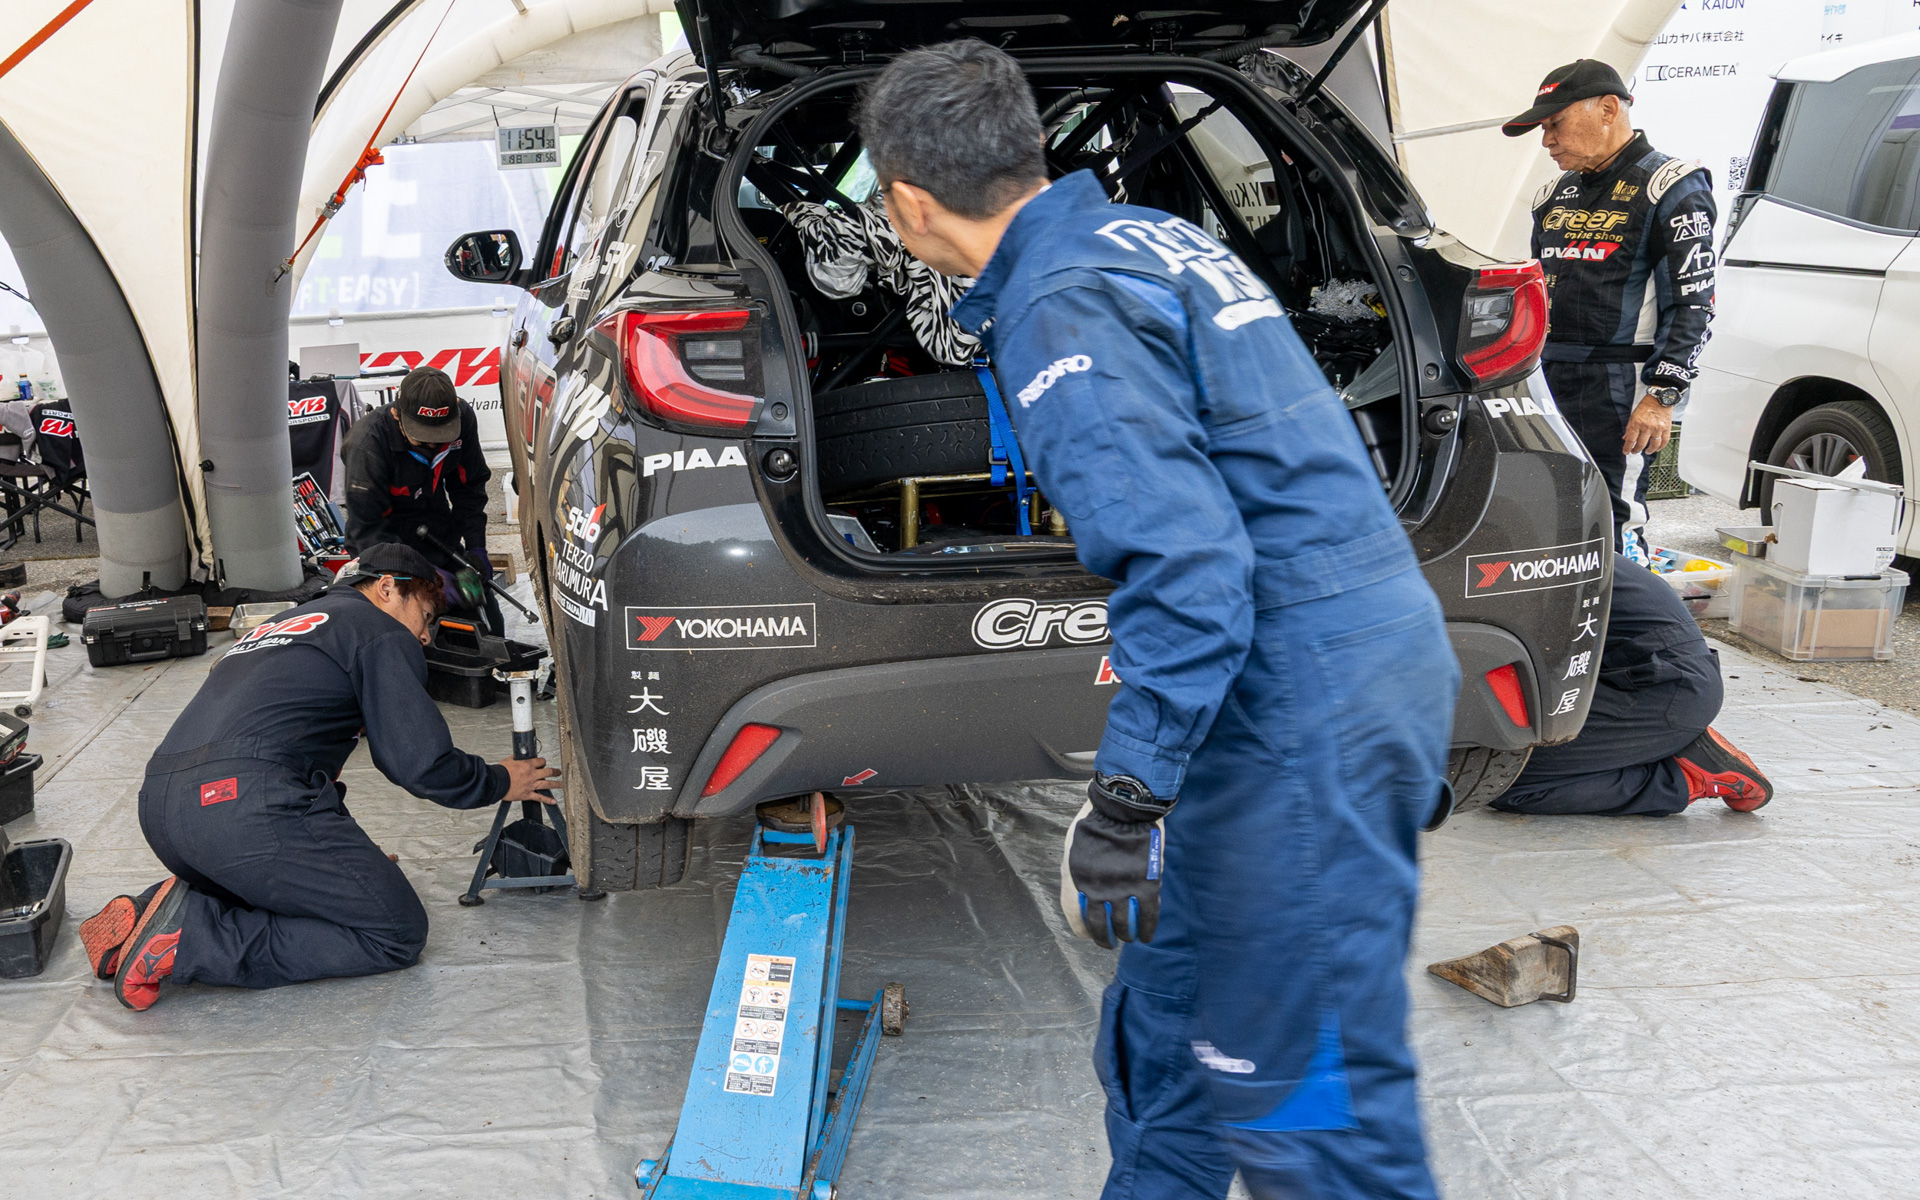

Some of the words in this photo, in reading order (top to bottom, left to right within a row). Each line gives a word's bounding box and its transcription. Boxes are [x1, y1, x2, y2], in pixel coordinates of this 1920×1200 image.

[1654, 31, 1744, 45] 山カヤバ株式会社
[1668, 65, 1737, 79] CERAMETA
[507, 128, 545, 150] 11:54
[1542, 206, 1629, 231] Creer
[1594, 232, 1624, 243] shop
[600, 241, 637, 279] SPK
[288, 396, 327, 417] YB
[418, 406, 450, 417] KYB
[1482, 397, 1560, 419] PIAA
[643, 446, 748, 477] PIAA
[565, 503, 607, 544] stilo
[562, 538, 595, 573] TERZO
[1509, 551, 1600, 582] YOKOHAMA
[675, 616, 808, 639] YOKOHAMA
[971, 598, 1112, 650] Cre
